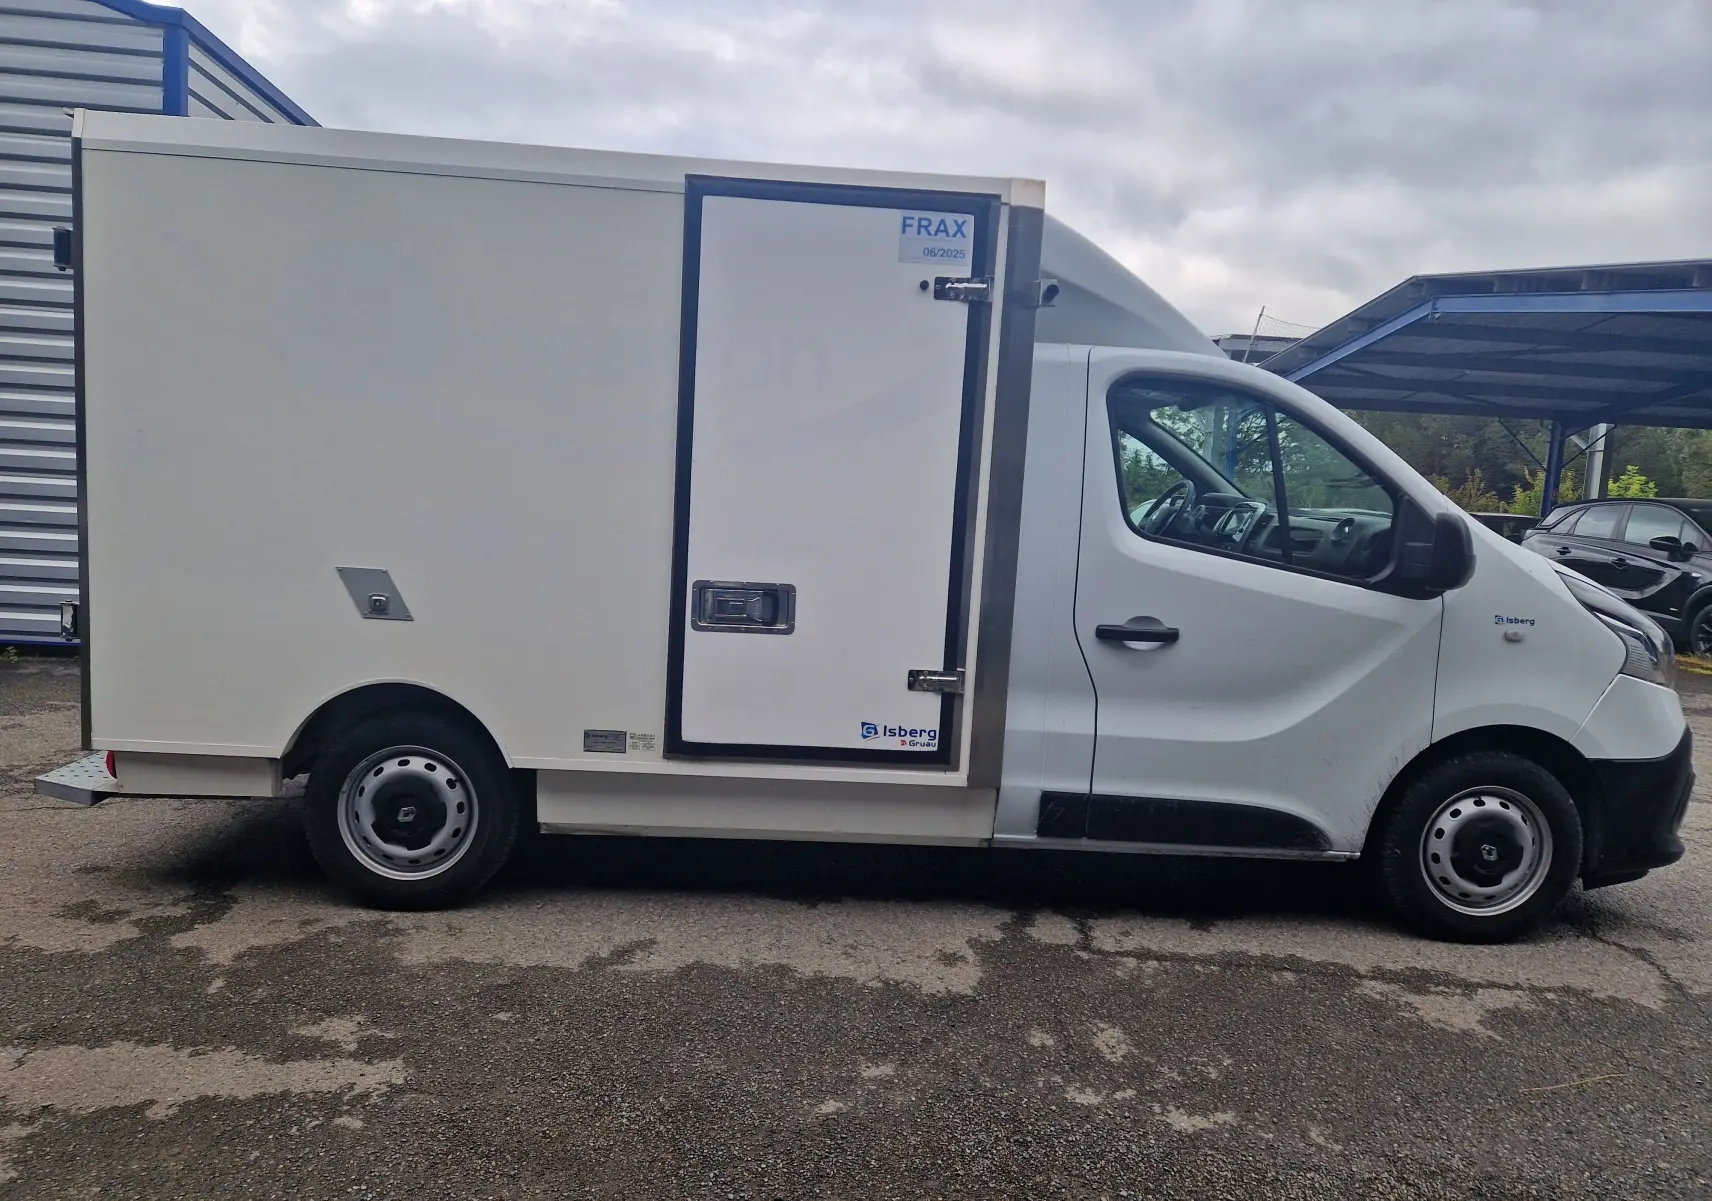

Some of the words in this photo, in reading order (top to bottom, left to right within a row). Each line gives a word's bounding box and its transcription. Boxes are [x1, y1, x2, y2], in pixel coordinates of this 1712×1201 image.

[901, 216, 967, 239] FRAX
[923, 247, 966, 259] 06/2025
[1506, 616, 1535, 627] Isberg
[883, 725, 937, 741] Isberg
[909, 740, 937, 748] Gruau
